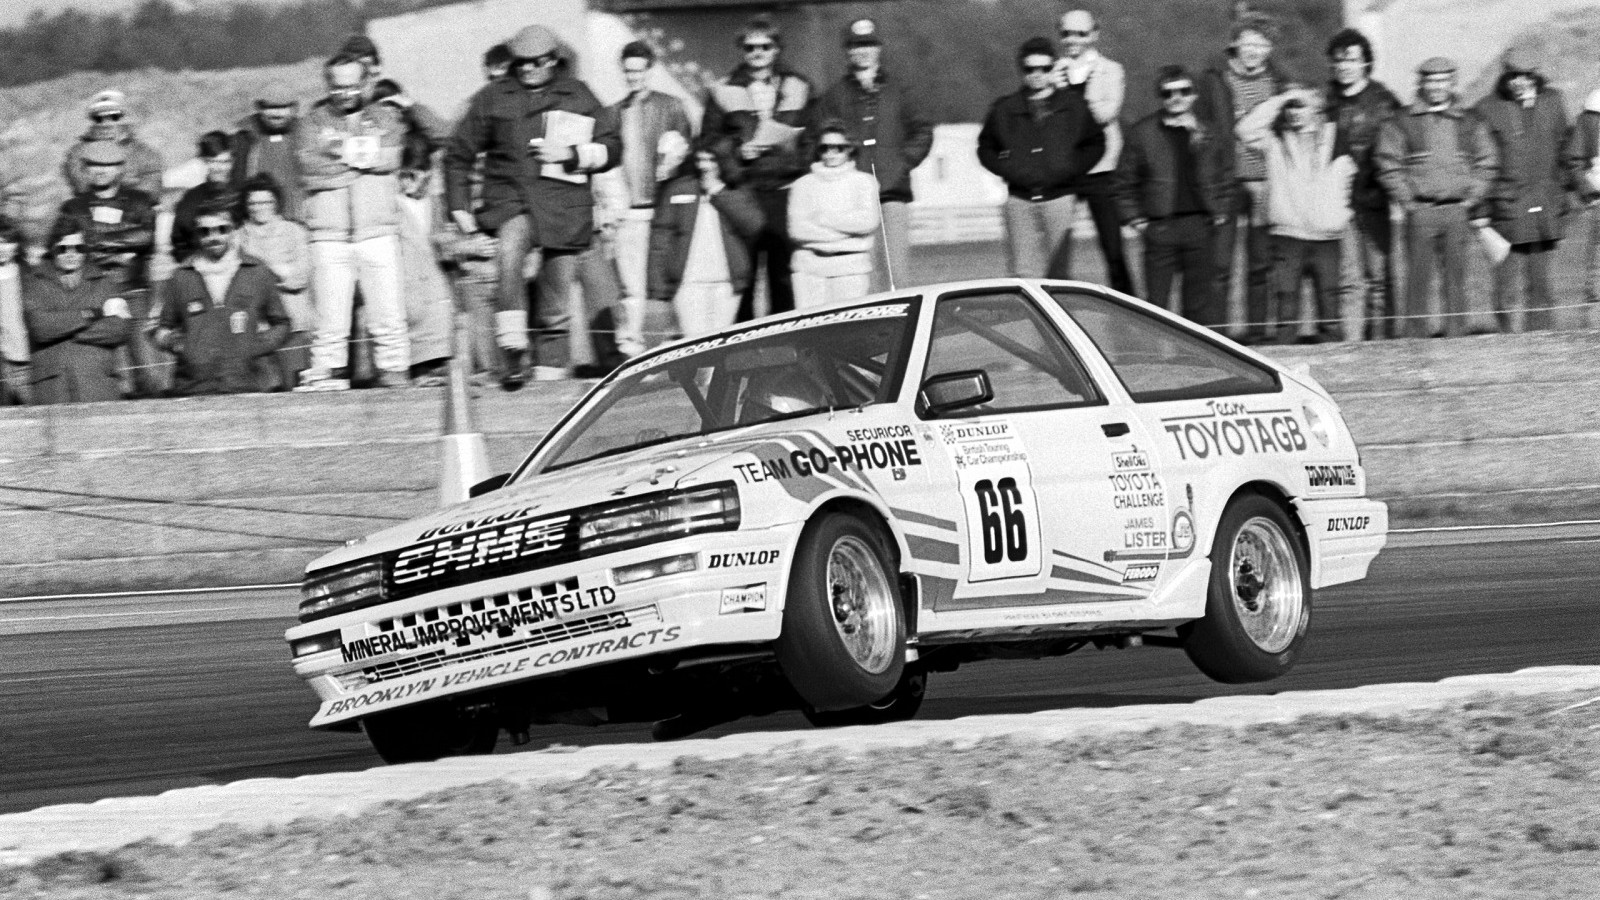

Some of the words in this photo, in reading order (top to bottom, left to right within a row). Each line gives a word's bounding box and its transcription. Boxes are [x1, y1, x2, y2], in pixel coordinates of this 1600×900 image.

[1206, 401, 1248, 416] Team
[847, 425, 912, 441] SECURICOR
[956, 424, 1009, 438] DUNLOP
[734, 457, 791, 483] TEAM
[791, 439, 922, 476] GO-PHONE
[1115, 456, 1133, 468] Shell
[1108, 473, 1161, 491] TOYOTA
[1113, 493, 1164, 509] CHALLENGE
[974, 477, 1027, 564] 66
[1124, 517, 1154, 529] JAMES
[1326, 516, 1370, 532] DUNLOP
[1124, 531, 1167, 548] LISTER
[708, 550, 780, 569] DUNLOP
[1123, 566, 1159, 580] FERODO
[723, 592, 764, 606] CHAMPION
[341, 628, 413, 663] MINERAL
[573, 585, 617, 611] LTD
[326, 679, 433, 717] BROOKLYN
[441, 657, 531, 688] VEHICLE
[532, 625, 683, 669] CONTRACTS
